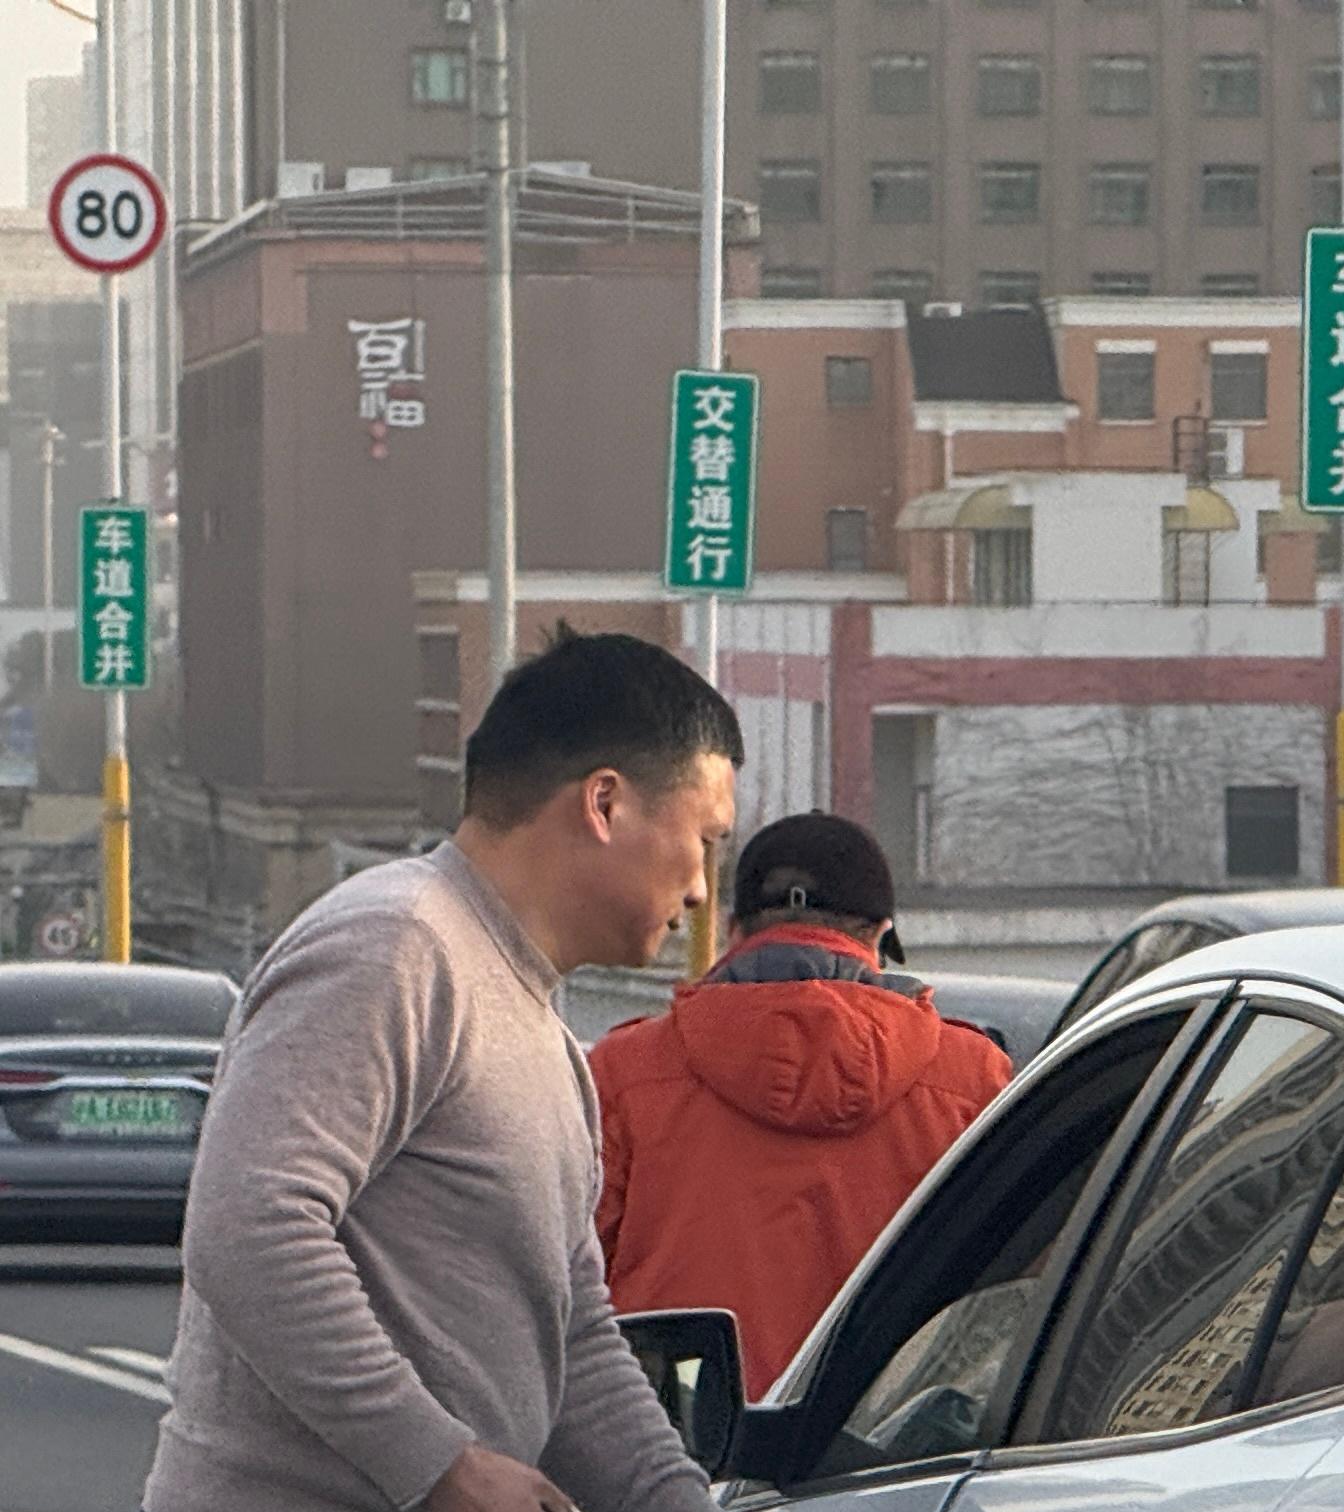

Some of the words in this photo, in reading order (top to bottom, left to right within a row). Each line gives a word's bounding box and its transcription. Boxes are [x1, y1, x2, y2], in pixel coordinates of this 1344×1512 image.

[76, 189, 144, 240] 80
[685, 384, 737, 583] 交替通行
[93, 515, 135, 682] 车道合并
